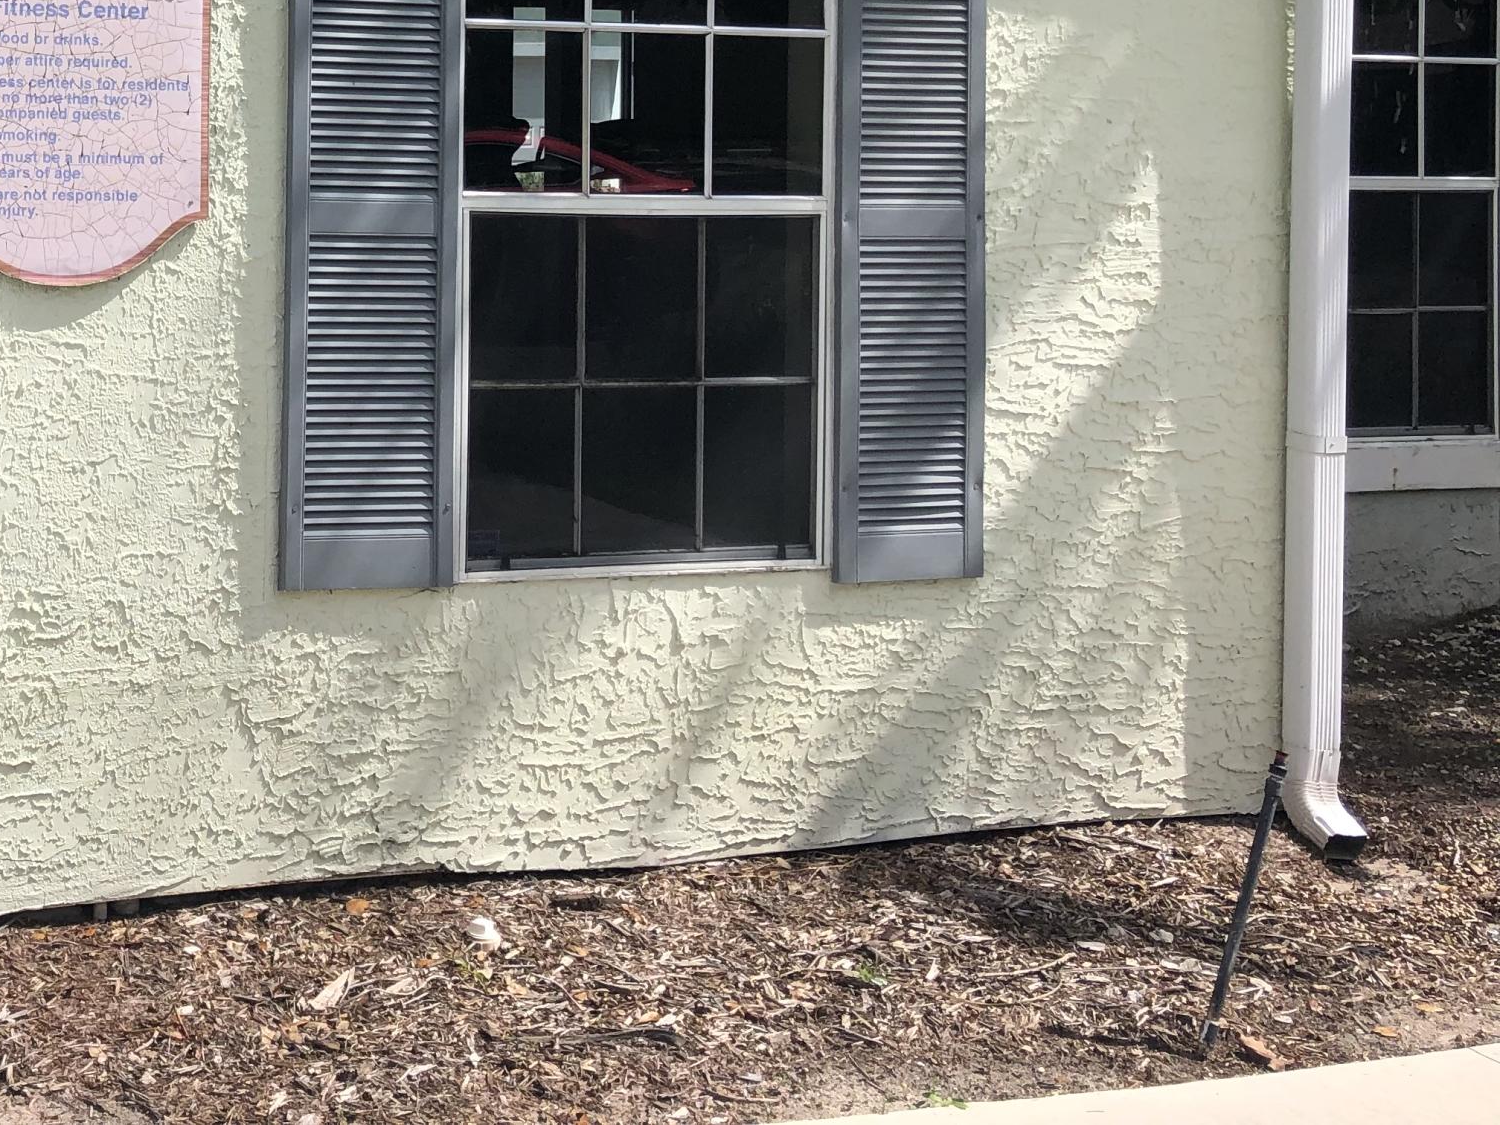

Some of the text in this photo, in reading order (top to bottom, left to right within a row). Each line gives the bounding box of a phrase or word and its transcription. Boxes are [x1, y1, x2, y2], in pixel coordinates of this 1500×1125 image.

[78, 0, 149, 19] Center
[35, 35, 49, 44] or
[54, 33, 103, 46] drinks.
[25, 55, 63, 66] attire
[68, 57, 132, 70] required.
[29, 77, 73, 88] center
[80, 77, 92, 89] is
[98, 77, 116, 90] for
[122, 78, 189, 91] residents
[2, 94, 20, 103] no
[25, 94, 63, 104] more
[67, 93, 98, 105] than
[104, 94, 129, 105] two
[134, 94, 152, 107] (2)
[73, 109, 125, 123] guests.
[2, 151, 37, 163] must
[43, 152, 60, 163] be
[66, 155, 73, 164] a
[79, 152, 145, 164] minimum
[150, 153, 164, 164] of
[36, 167, 50, 179] of
[54, 169, 84, 182] age.
[24, 190, 47, 200] not
[52, 190, 138, 203] responsible
